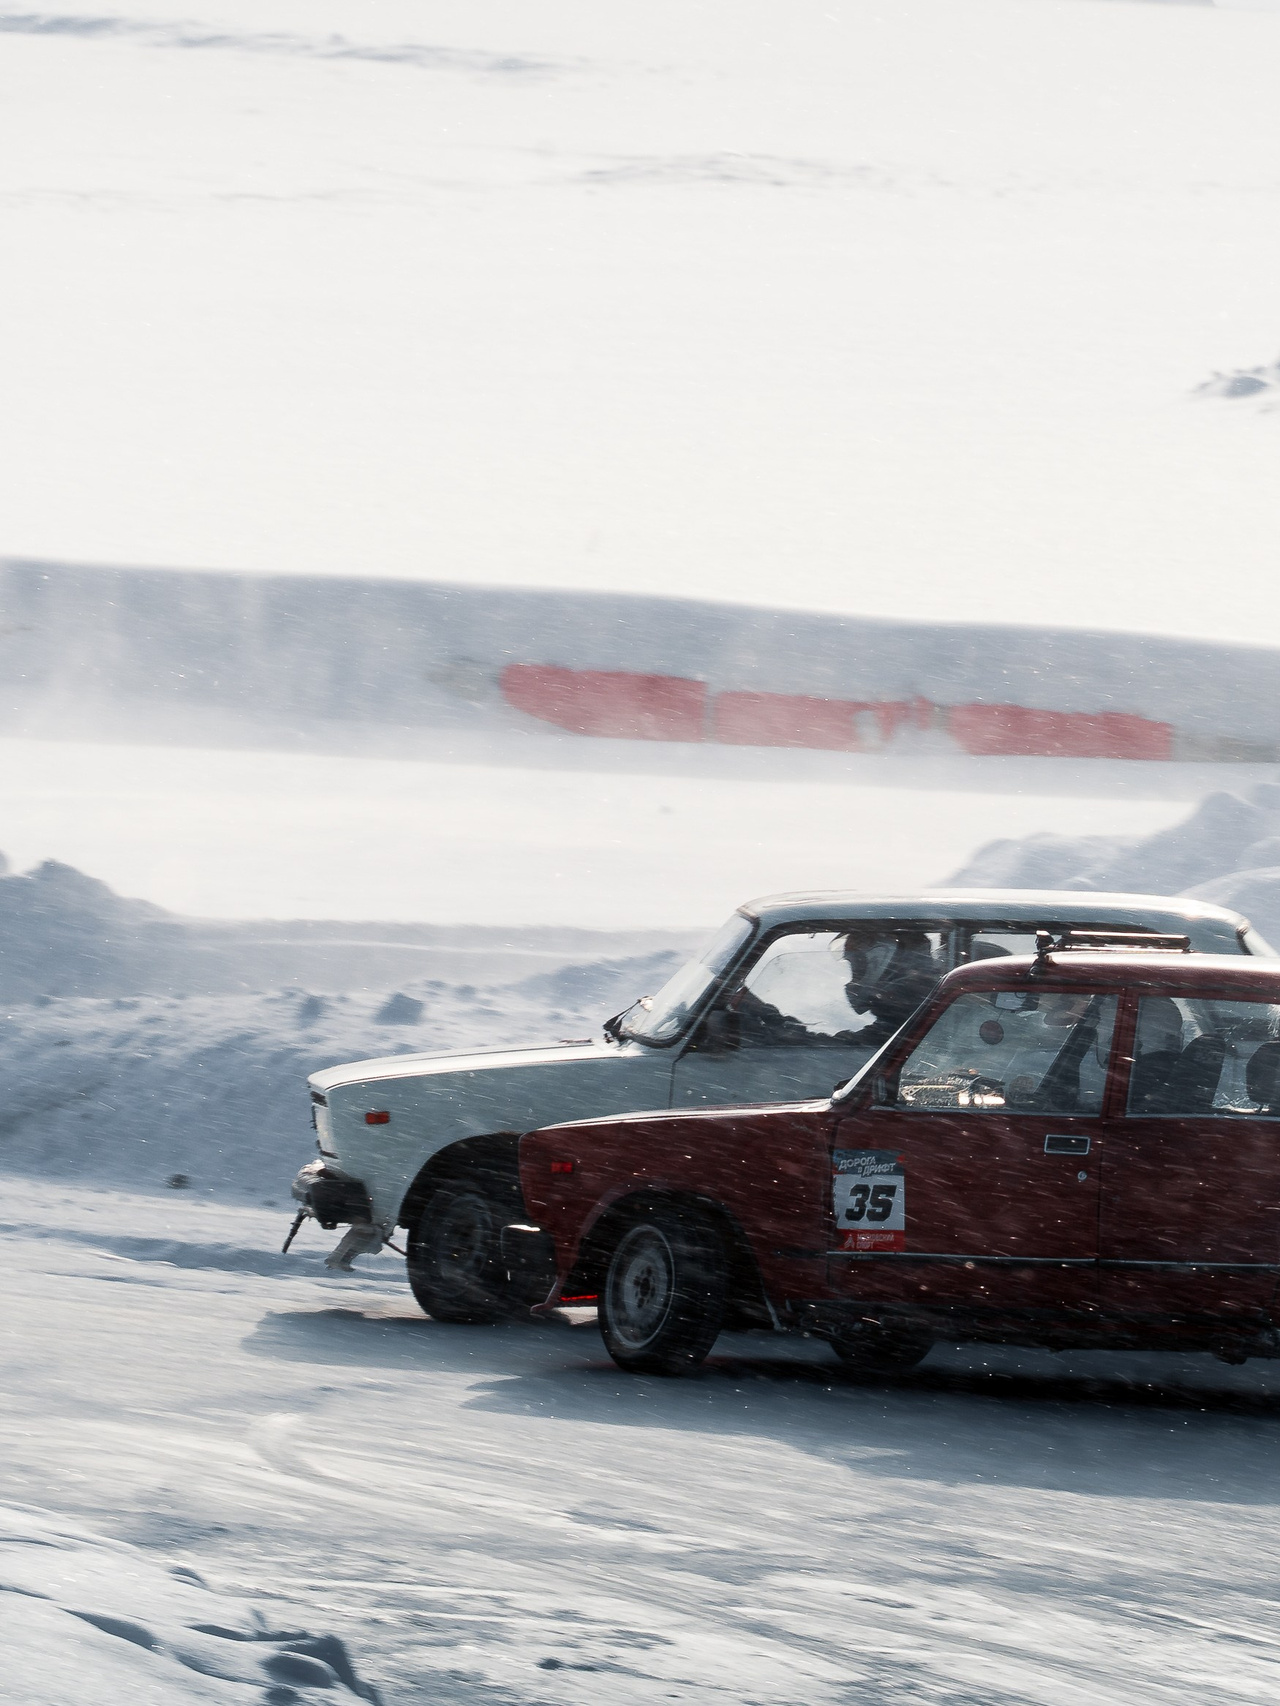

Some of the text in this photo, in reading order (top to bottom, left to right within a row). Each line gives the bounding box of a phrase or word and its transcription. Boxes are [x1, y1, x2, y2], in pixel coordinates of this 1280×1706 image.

[838, 1156, 876, 1171] ДОРОГА
[863, 1163, 896, 1175] ДРИФТ
[845, 1184, 897, 1221] 35
